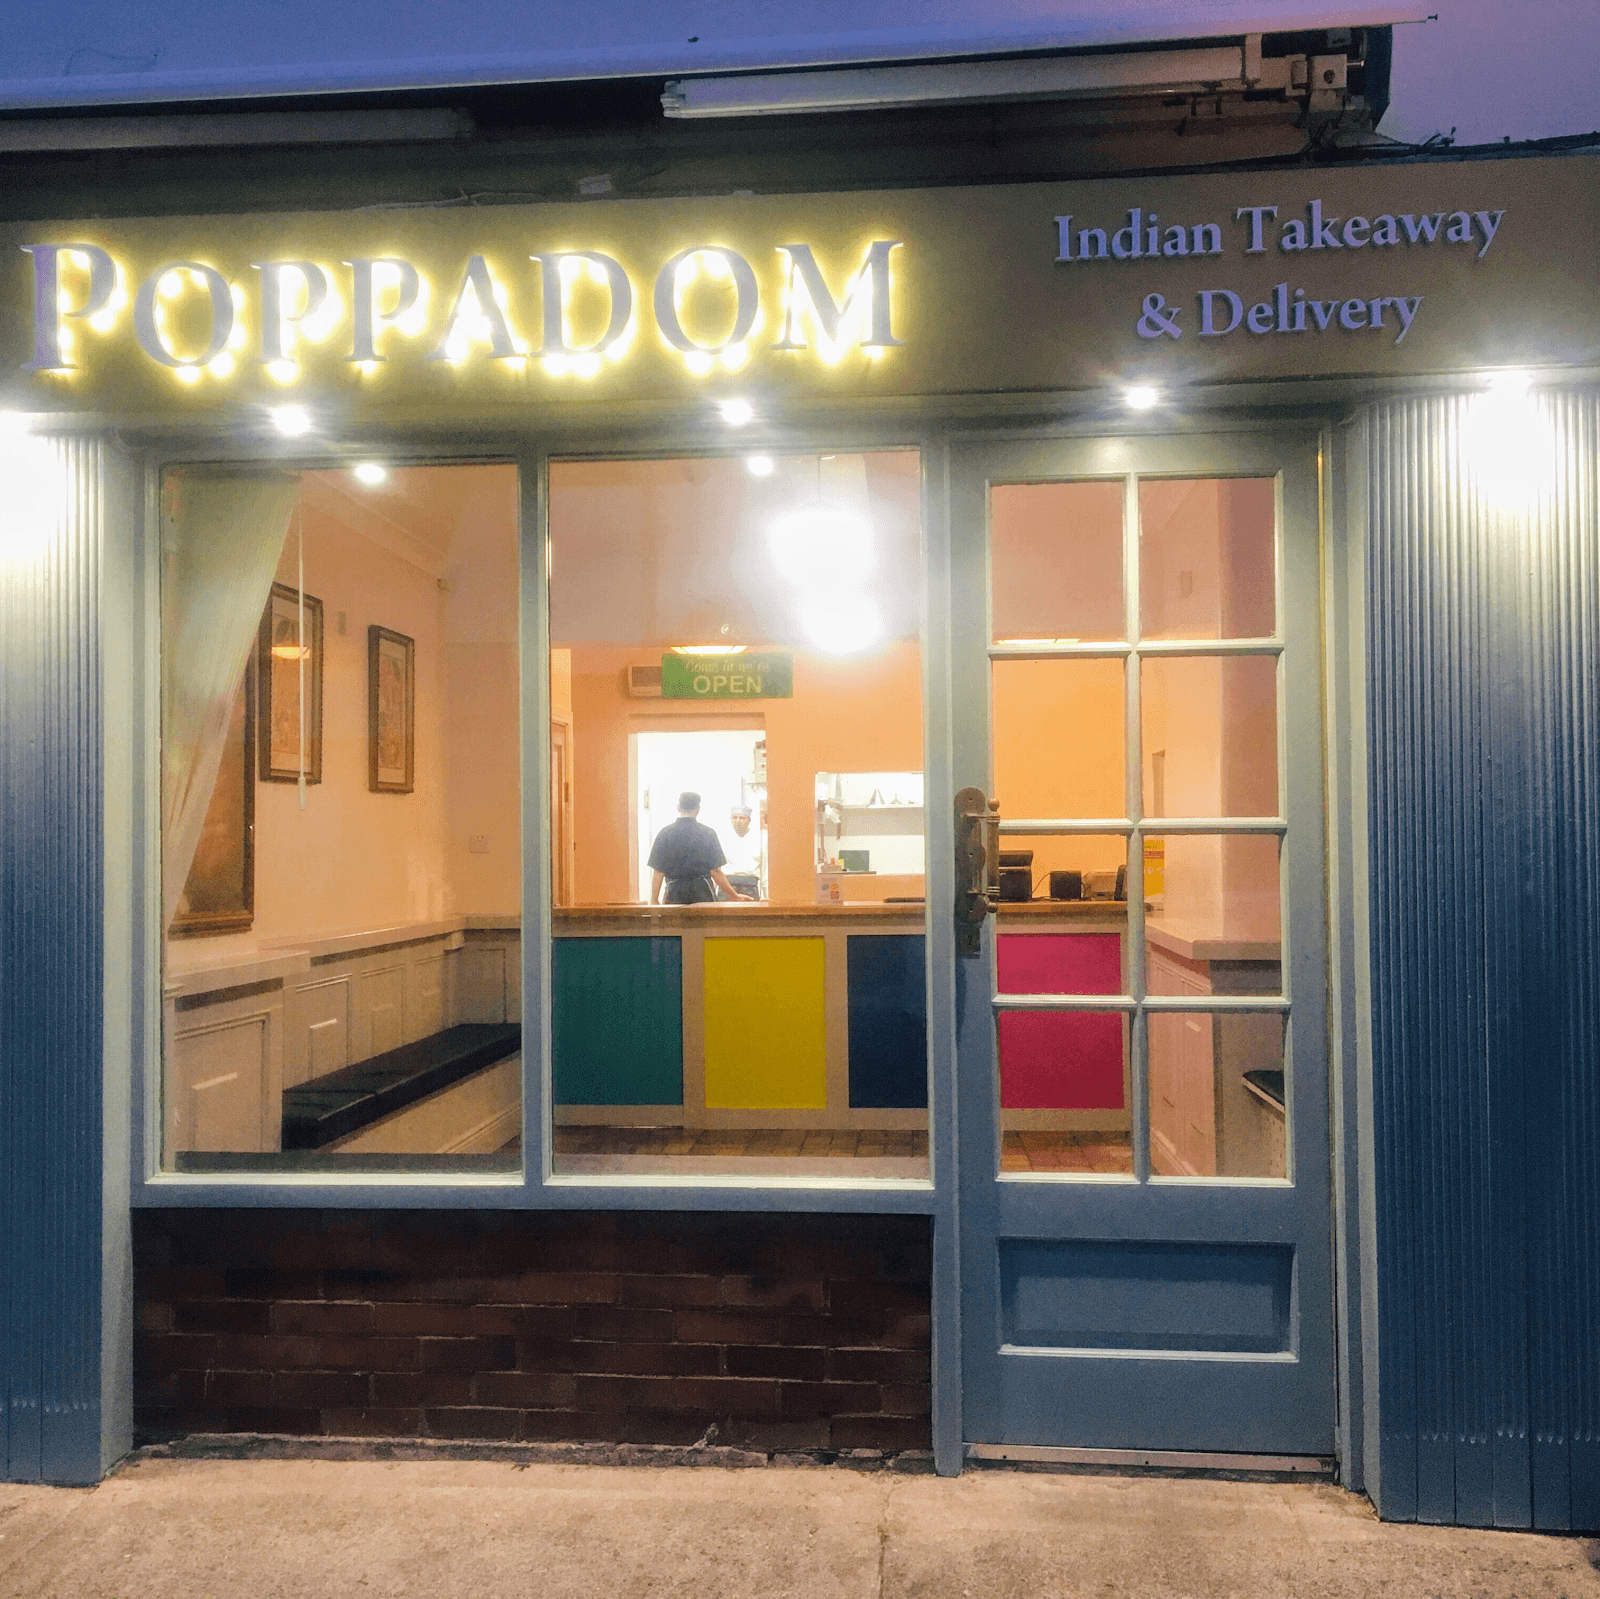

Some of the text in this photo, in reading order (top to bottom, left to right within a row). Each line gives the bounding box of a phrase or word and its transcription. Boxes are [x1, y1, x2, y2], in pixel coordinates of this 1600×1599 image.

[1053, 199, 1506, 263] Indian Takeaway
[1136, 282, 1424, 344] & Delivery
[692, 675, 763, 694] OPEN
